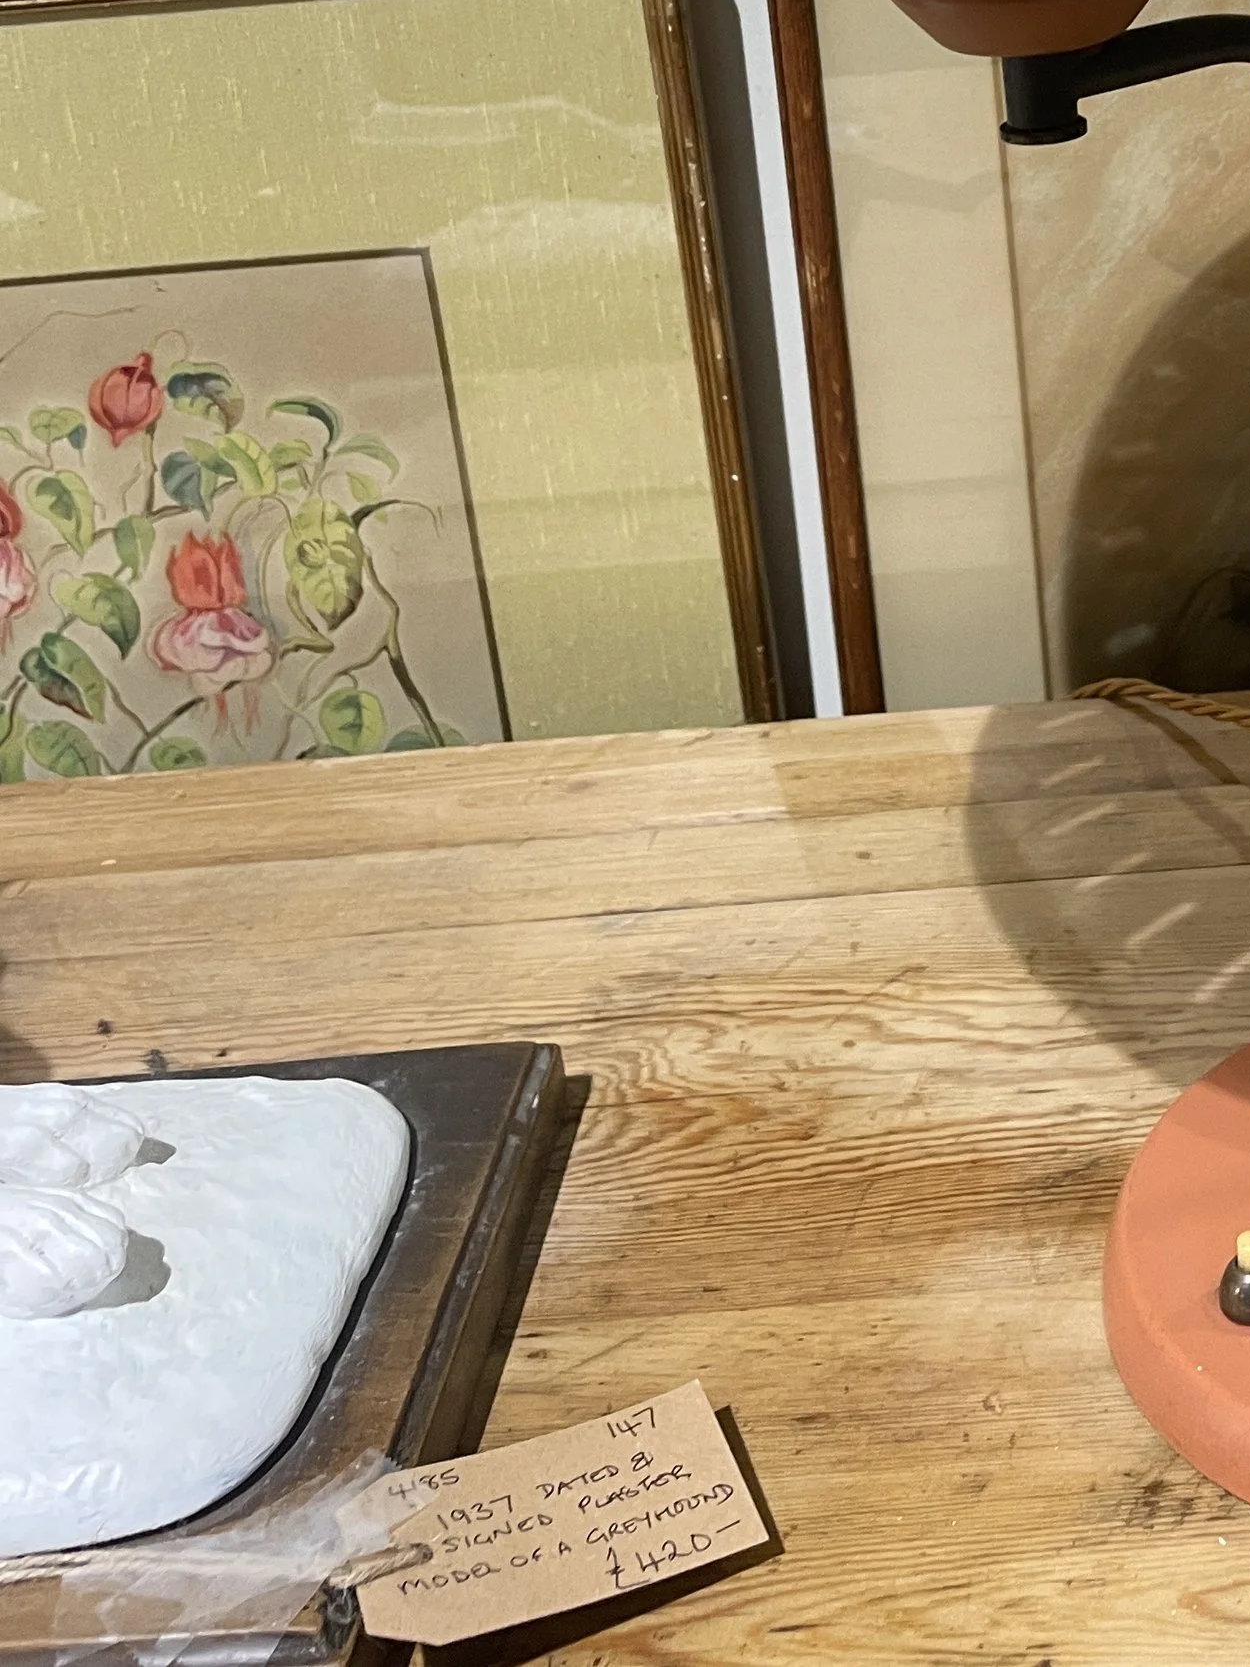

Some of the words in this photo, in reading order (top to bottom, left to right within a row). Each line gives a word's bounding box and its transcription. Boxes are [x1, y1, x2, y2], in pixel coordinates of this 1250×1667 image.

[606, 1407, 655, 1440] 147
[436, 1495, 514, 1531] 1937
[536, 1463, 620, 1501] DATED
[630, 1451, 655, 1476] &
[442, 1513, 554, 1554] SIGNED
[577, 1463, 693, 1513] PLASTER
[398, 1566, 503, 1596] MODEL
[510, 1549, 543, 1570] OF
[558, 1540, 573, 1557] A
[585, 1484, 736, 1547] GREYHOUND
